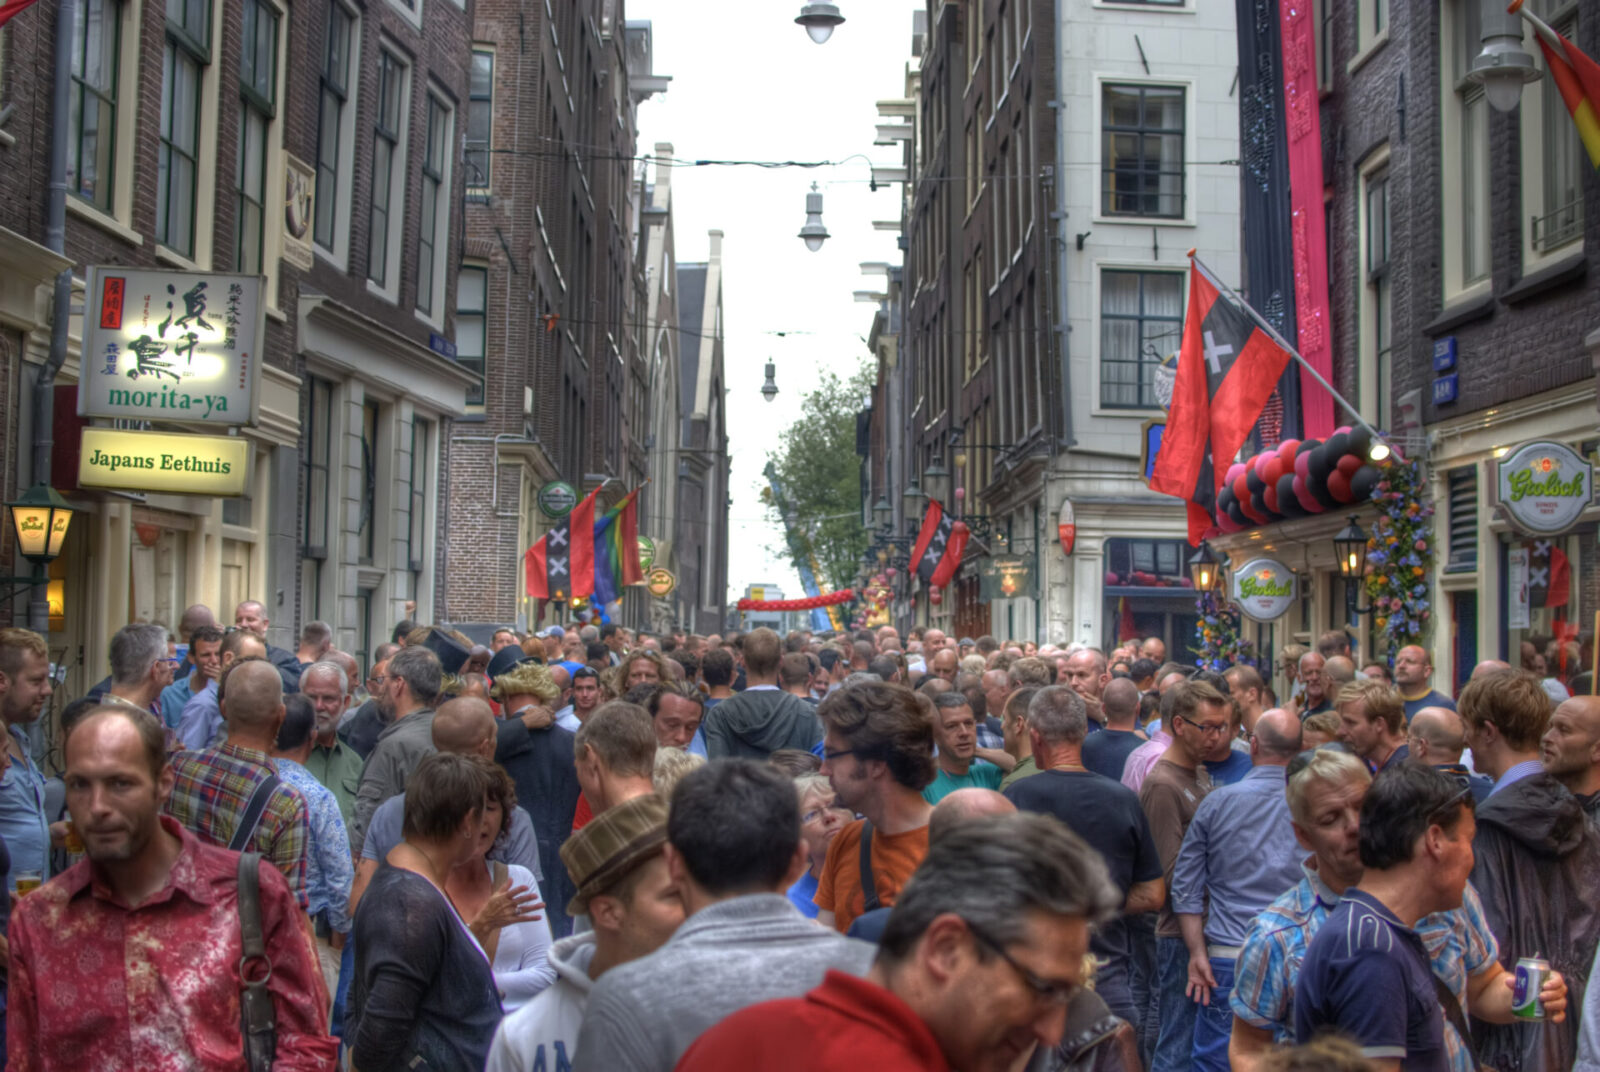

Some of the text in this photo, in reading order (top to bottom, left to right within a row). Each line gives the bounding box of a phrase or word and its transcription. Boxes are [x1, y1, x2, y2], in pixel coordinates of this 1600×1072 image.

[108, 384, 229, 419] morita-ya
[89, 449, 231, 474] Japans Eethuis
[1507, 468, 1584, 502] Grolsch
[1239, 575, 1293, 600] Grolsch
